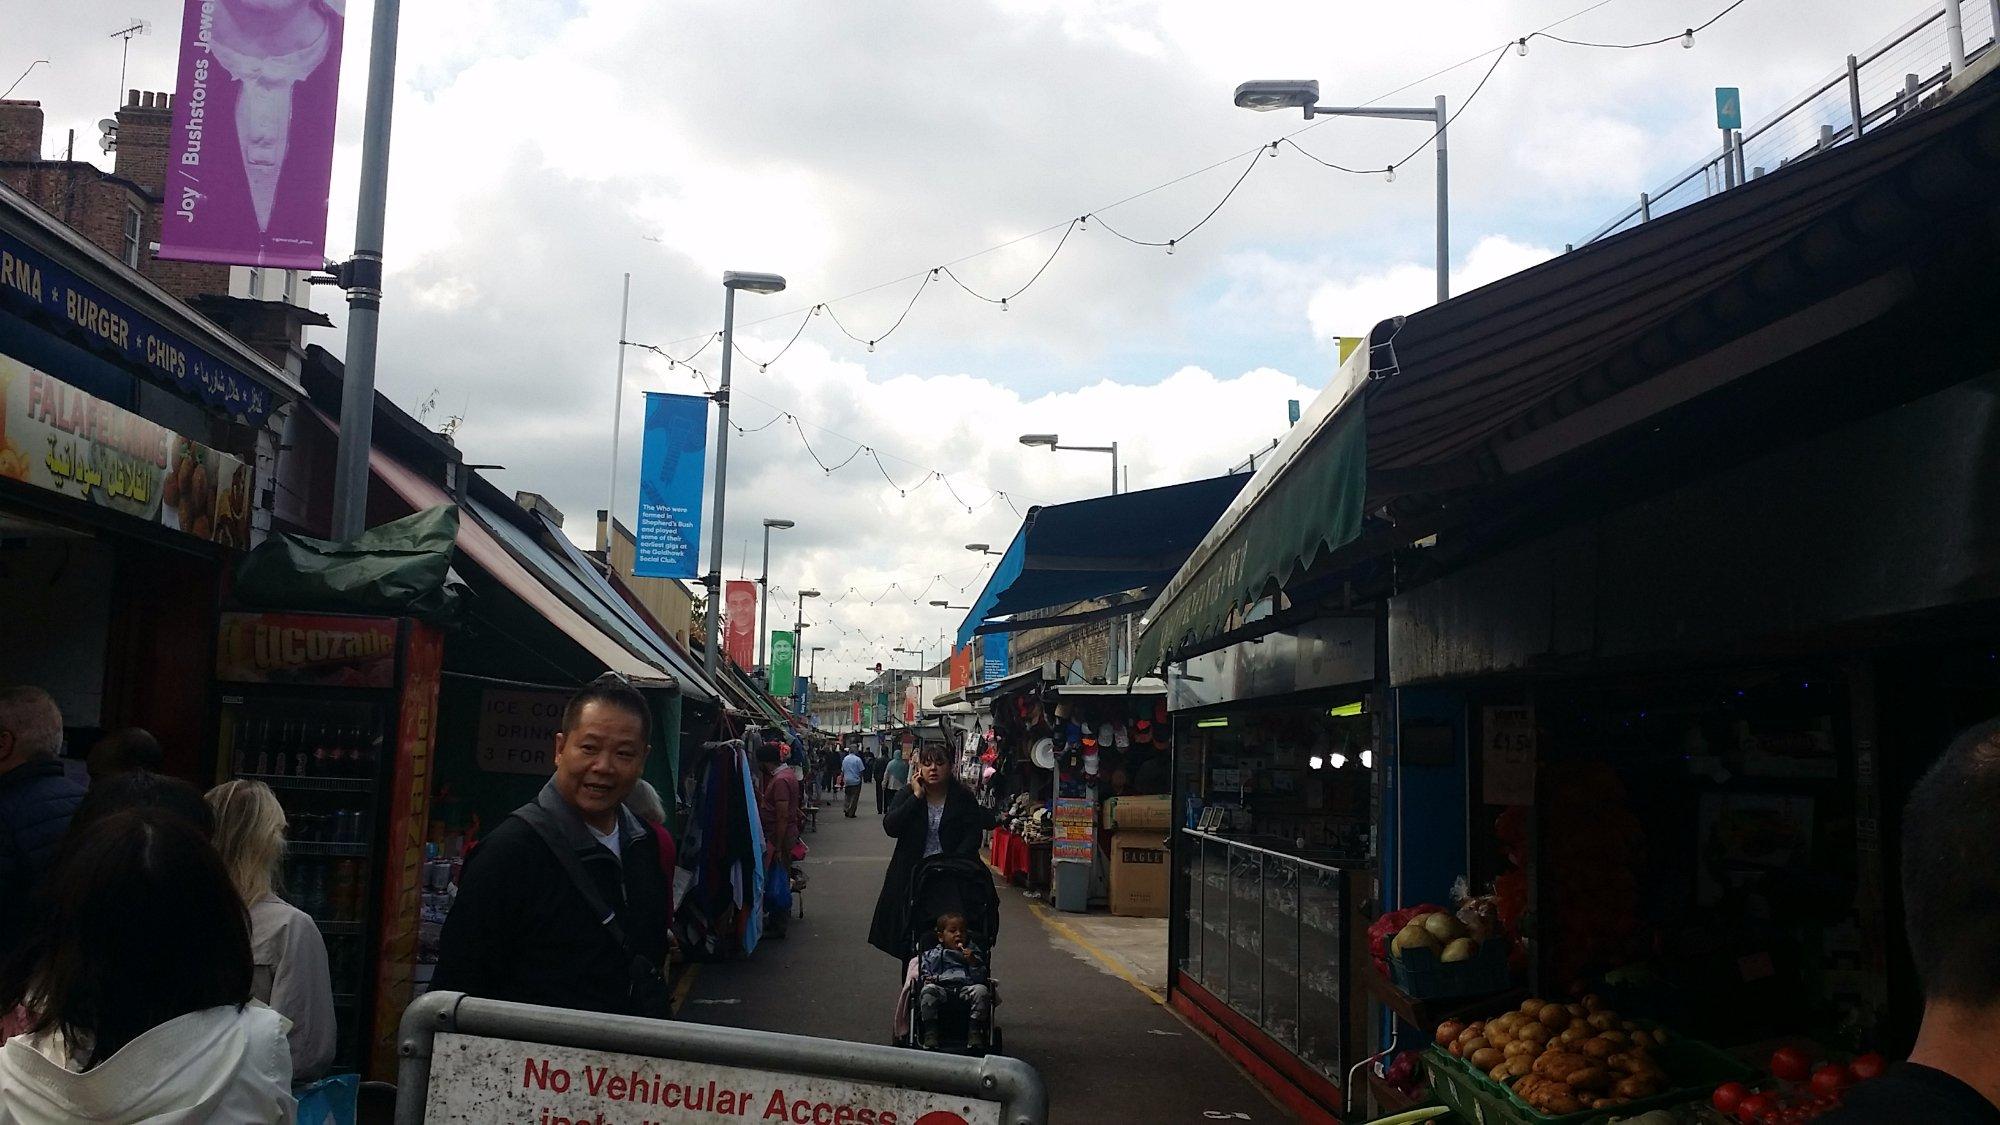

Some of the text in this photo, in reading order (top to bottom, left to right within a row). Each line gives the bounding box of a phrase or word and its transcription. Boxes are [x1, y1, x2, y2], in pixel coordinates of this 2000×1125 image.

[194, 0, 214, 53] Jewe
[182, 59, 209, 165] Bushstores
[1721, 96, 1736, 118] 4
[177, 187, 201, 223] Joy
[1, 250, 186, 379] RMA BURGER CHIPS
[27, 369, 120, 450] FALAFEL
[642, 519, 693, 528] Shepherd's Bush
[655, 527, 677, 535] played
[652, 549, 685, 557] Goldhawk
[665, 543, 679, 551] gigs
[487, 699, 519, 715] ICE
[484, 747, 545, 764] 3 FOR
[523, 1058, 571, 1094] No
[584, 1065, 752, 1116] Vehicular
[763, 1088, 898, 1125] Access
